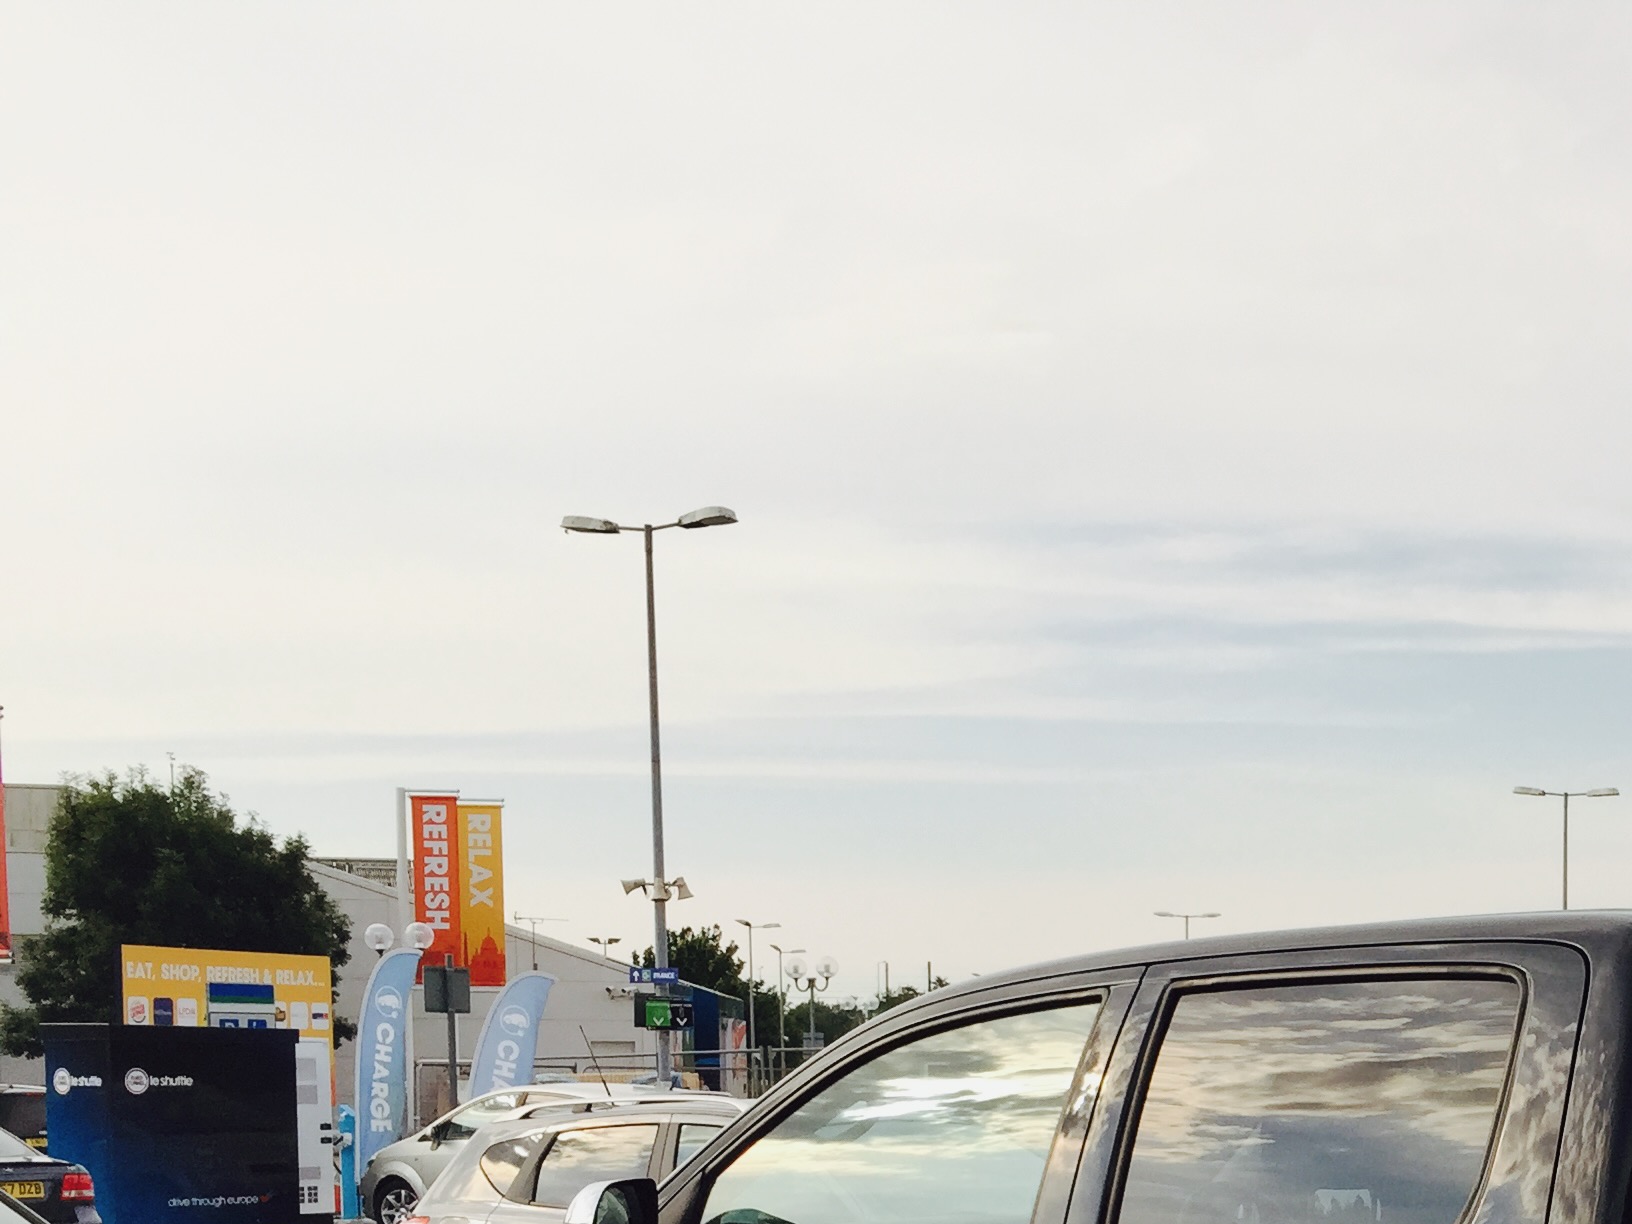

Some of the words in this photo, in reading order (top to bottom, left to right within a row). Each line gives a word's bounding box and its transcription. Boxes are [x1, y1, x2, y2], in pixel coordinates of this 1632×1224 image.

[422, 804, 450, 929] REFRESH
[467, 813, 494, 908] RELAX
[126, 961, 156, 980] EAT,
[161, 964, 201, 982] SHOP,
[206, 965, 259, 984] REFRESH
[262, 968, 272, 984] &
[160, 1075, 194, 1087] shuttle
[370, 1022, 395, 1132] CHARGE
[168, 1198, 190, 1207] drive
[191, 1196, 226, 1208] through
[226, 1195, 259, 1205] europe
